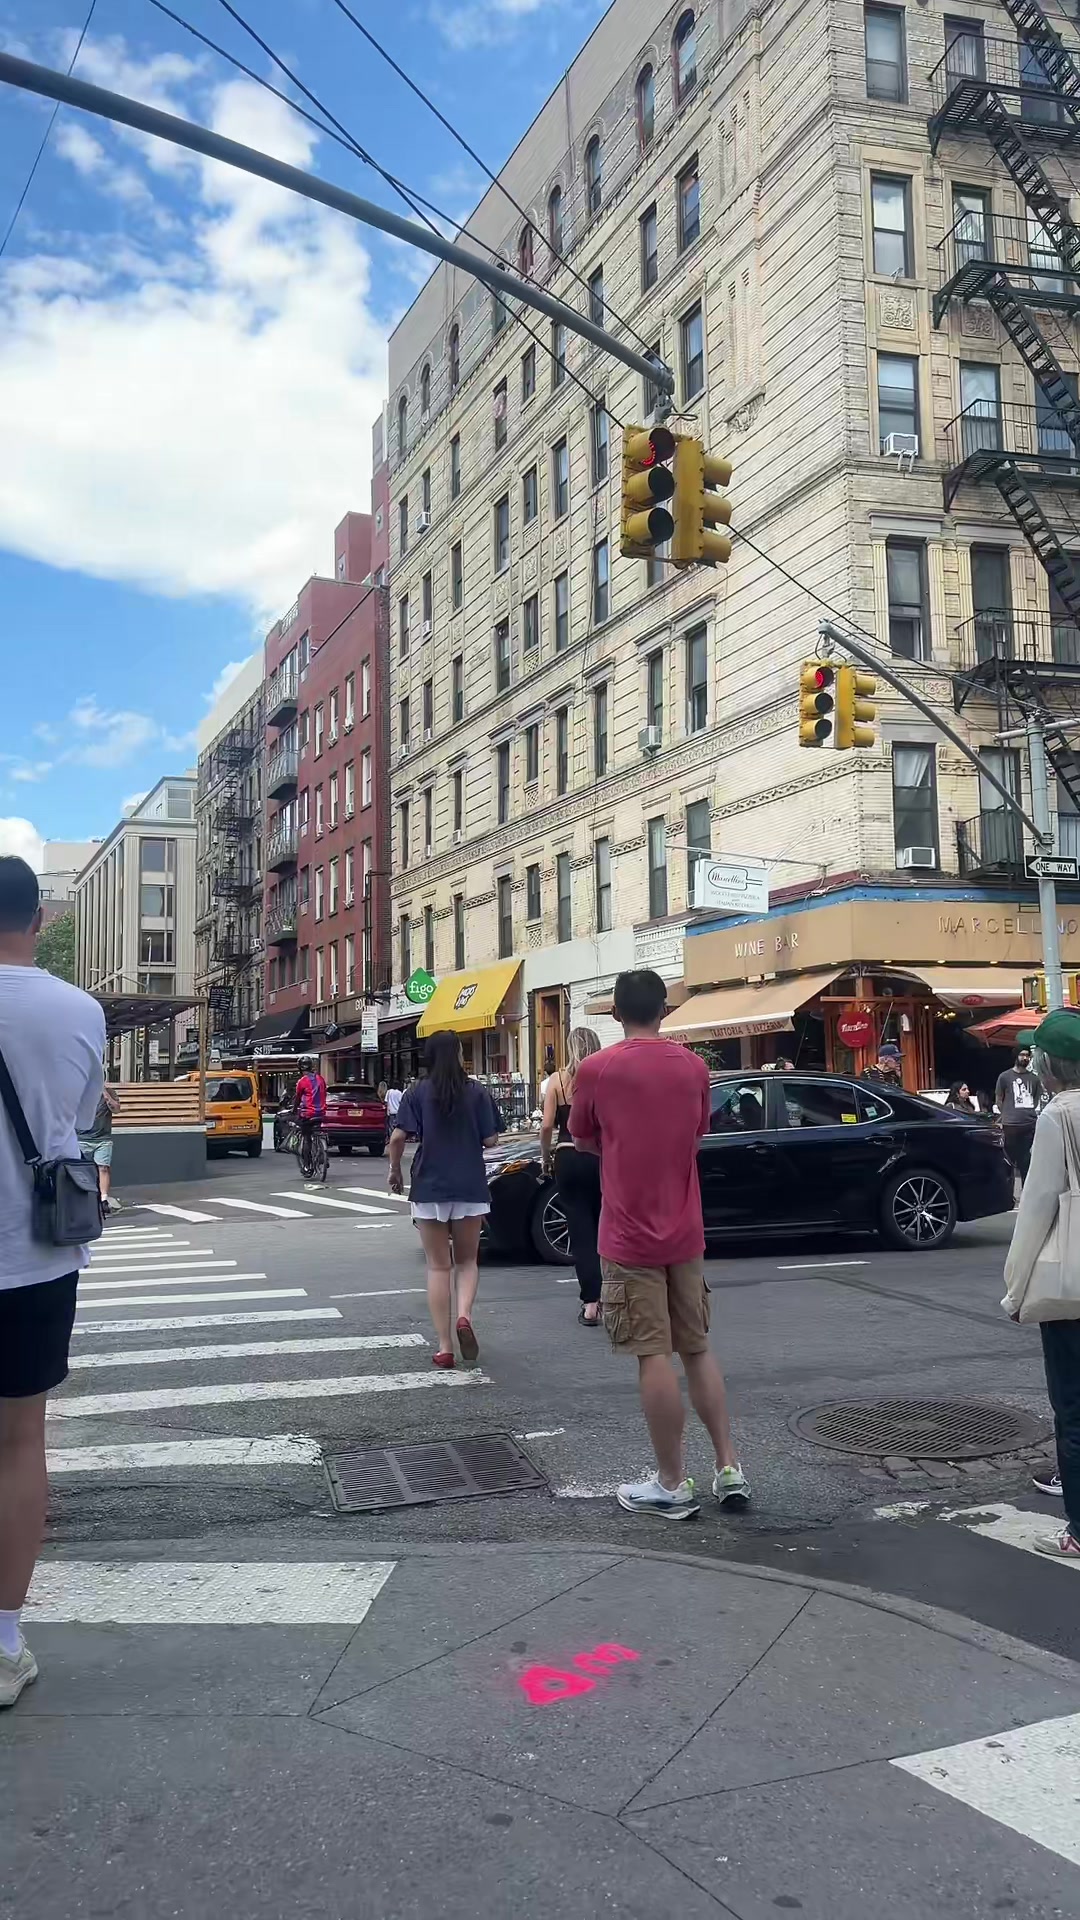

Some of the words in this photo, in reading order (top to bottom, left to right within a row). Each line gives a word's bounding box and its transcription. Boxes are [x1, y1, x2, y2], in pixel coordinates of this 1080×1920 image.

[1035, 862, 1050, 872] ONE
[1056, 863, 1073, 873] WAY
[938, 916, 1079, 937] MARCELLNO
[734, 939, 765, 958] WINE
[775, 932, 799, 952] BAR
[409, 980, 434, 1000] figo
[709, 1026, 744, 1039] TRATTORIA
[753, 1020, 786, 1034] PIZZERIA
